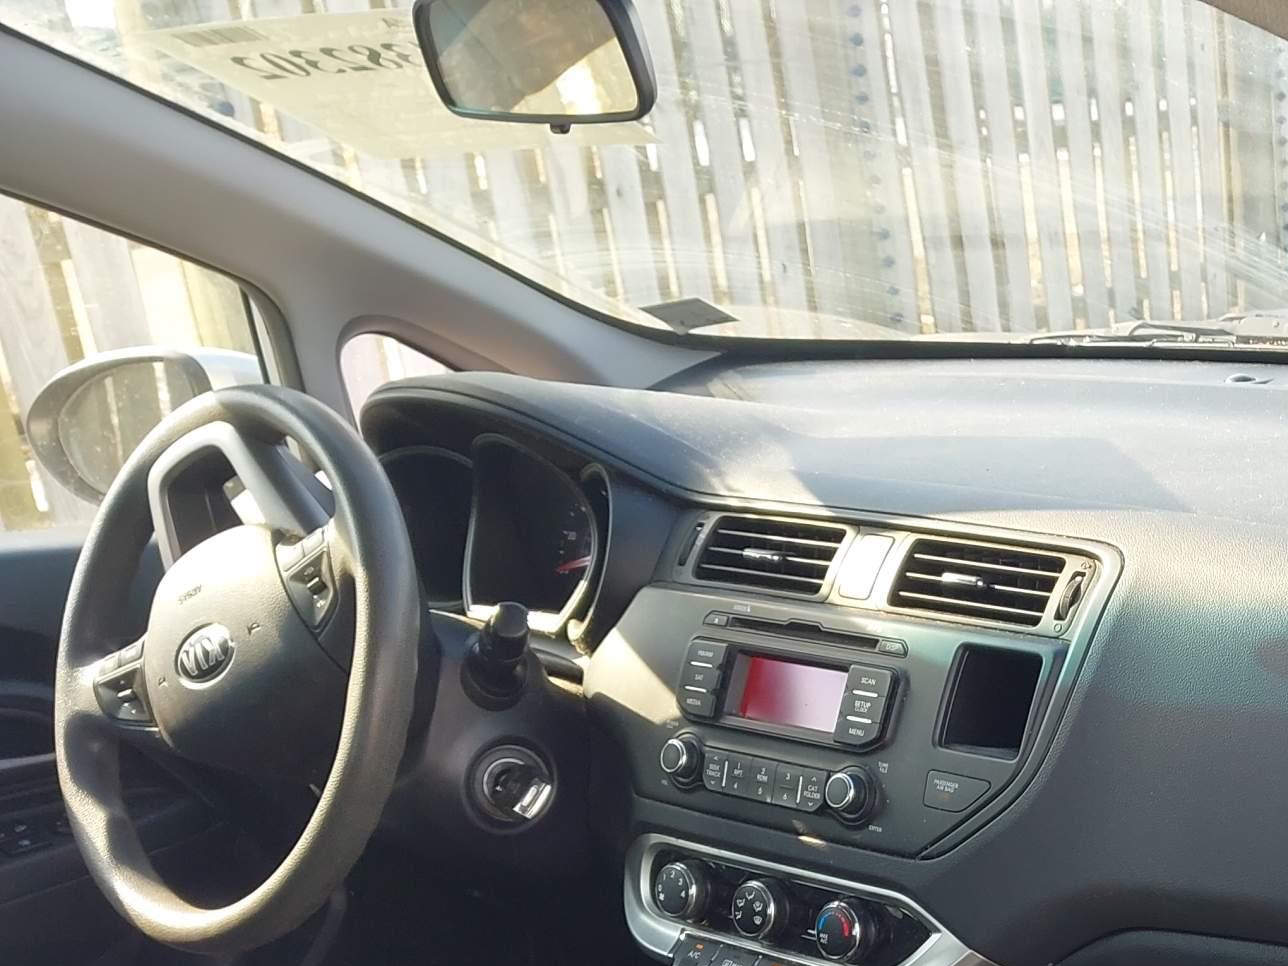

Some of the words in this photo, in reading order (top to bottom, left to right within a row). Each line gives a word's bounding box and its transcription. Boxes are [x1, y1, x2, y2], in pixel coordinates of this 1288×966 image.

[861, 677, 876, 685] SCAN
[848, 727, 865, 737] MENU
[688, 950, 701, 960] A/C
